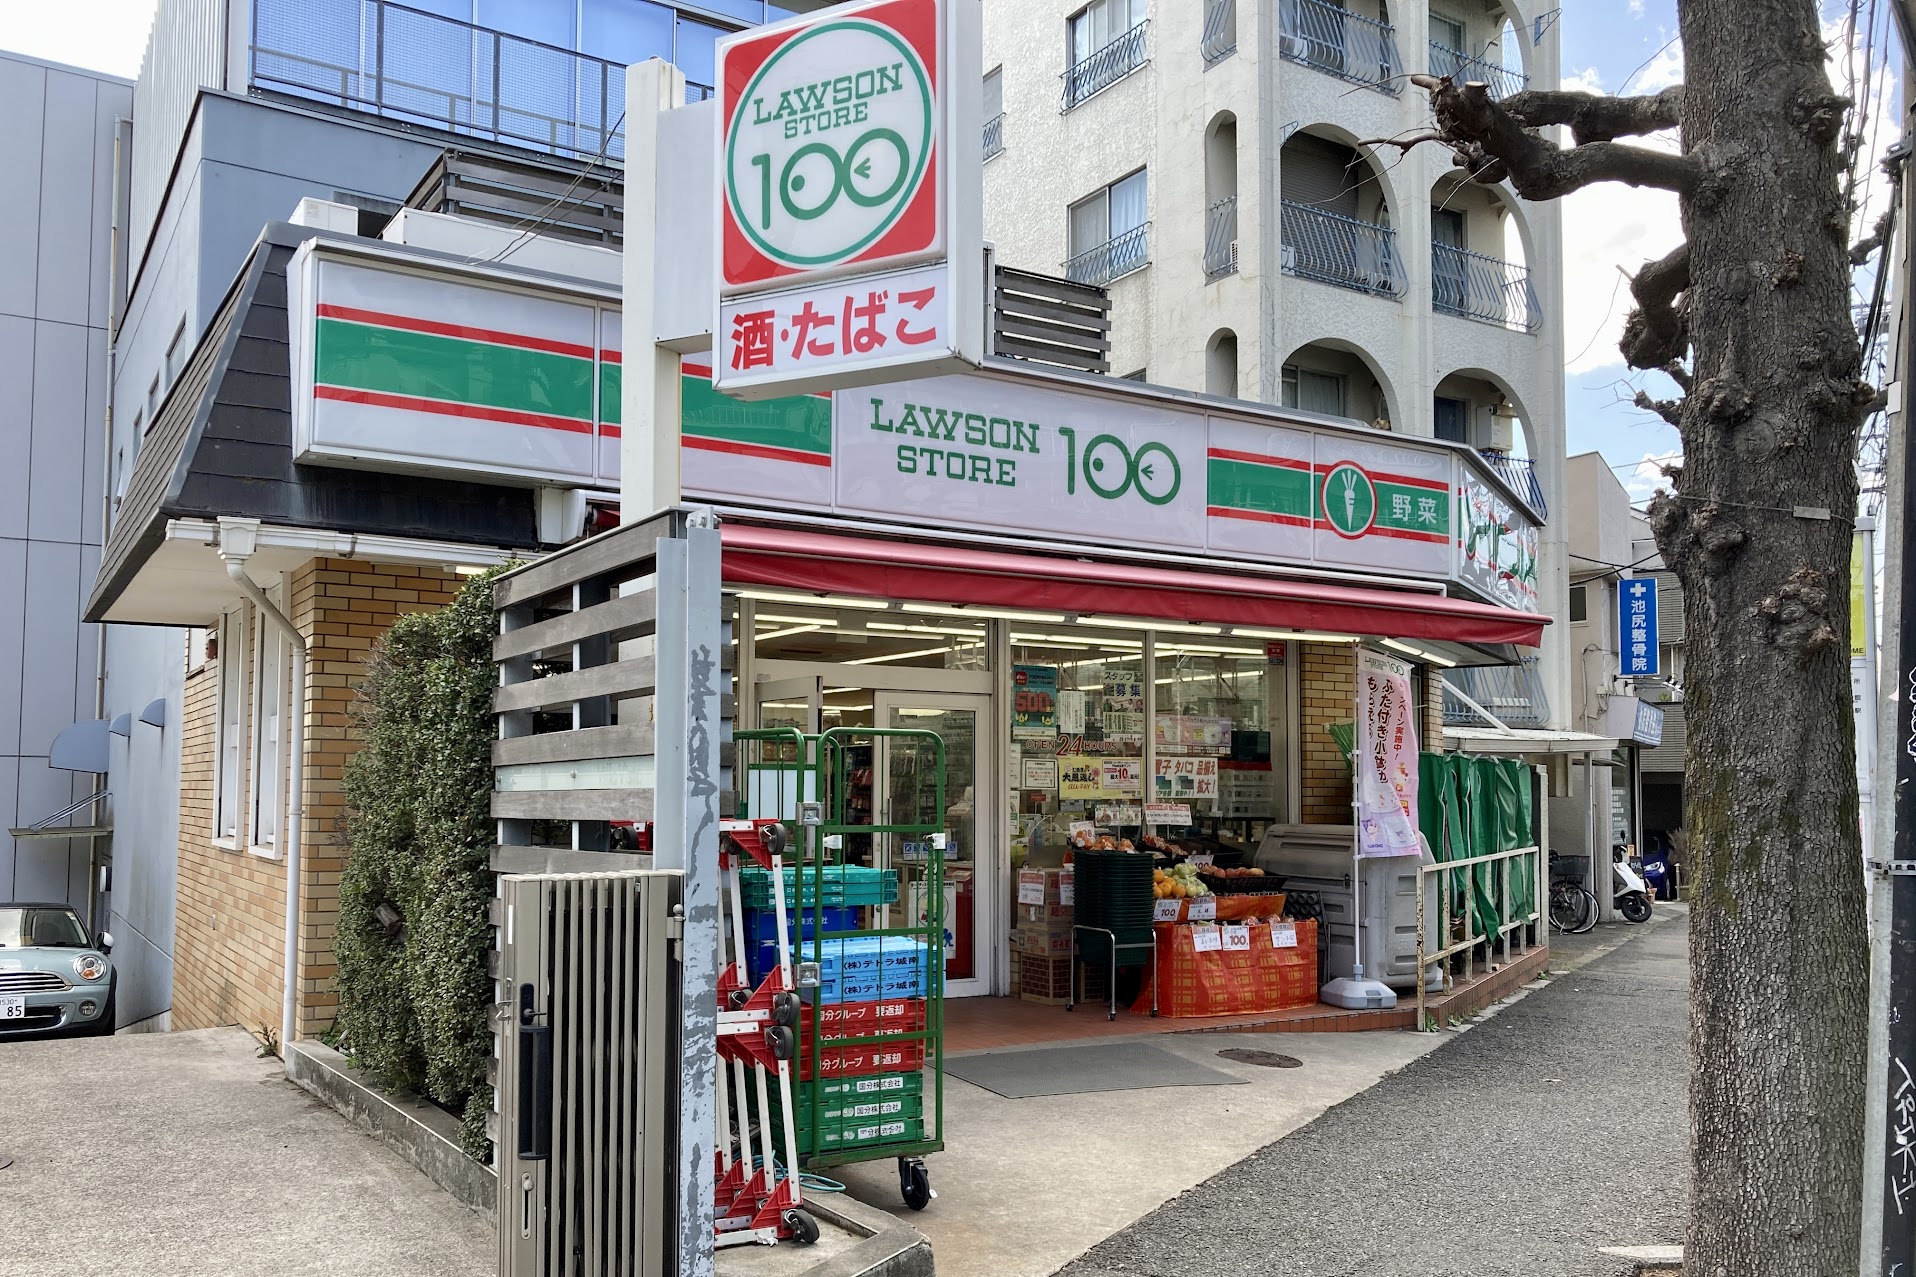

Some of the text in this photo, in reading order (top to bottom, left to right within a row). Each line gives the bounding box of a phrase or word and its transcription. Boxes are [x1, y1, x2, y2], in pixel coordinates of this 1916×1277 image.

[753, 62, 903, 126] LAWSON
[784, 101, 868, 140] STORE
[751, 127, 910, 231] 100
[870, 397, 1040, 454] LAWSON
[897, 444, 1016, 487] STORE
[1058, 426, 1181, 506] 100
[1391, 492, 1437, 525] 野菜
[1630, 599, 1648, 672] 池尻整骨院
[1026, 734, 1117, 756] OPEN 24 HOURS
[1161, 908, 1176, 917] 100
[1229, 935, 1247, 946] 100
[7, 1005, 22, 1017] 85
[858, 1079, 901, 1091] 国分株式会社
[856, 1103, 899, 1115] 国分株式会社
